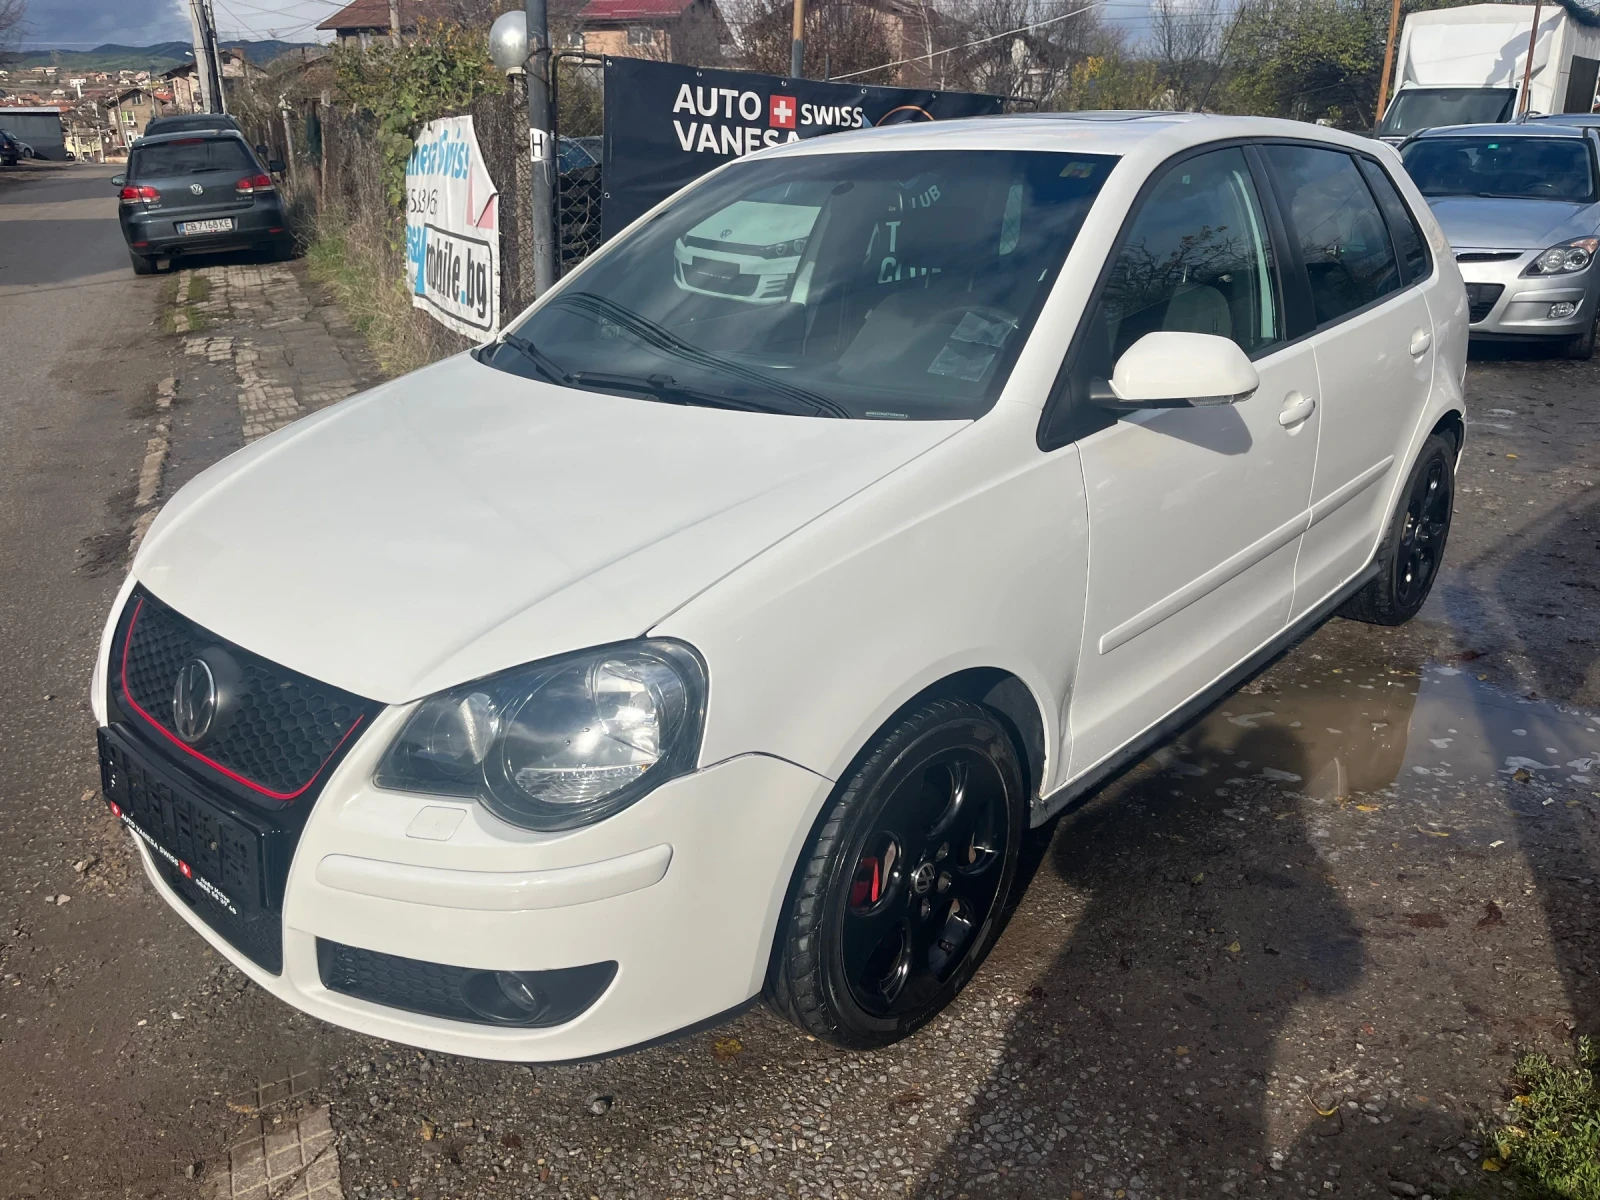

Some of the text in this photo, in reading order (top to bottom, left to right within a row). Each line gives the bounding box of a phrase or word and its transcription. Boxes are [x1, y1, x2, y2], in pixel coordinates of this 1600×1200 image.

[672, 83, 863, 128] AUTO SWISS
[531, 133, 543, 157] H
[426, 237, 487, 319] mobile.bg
